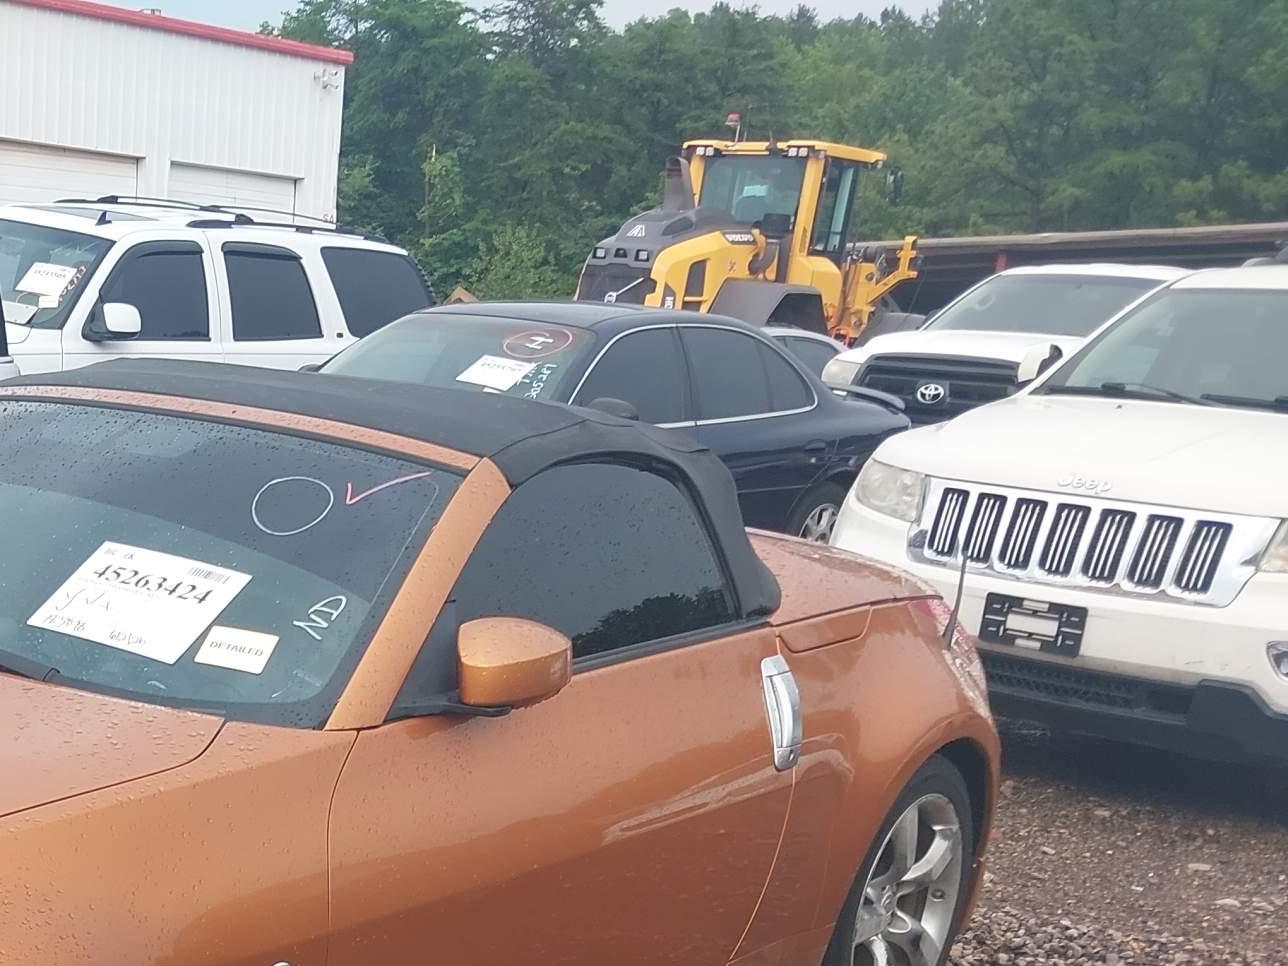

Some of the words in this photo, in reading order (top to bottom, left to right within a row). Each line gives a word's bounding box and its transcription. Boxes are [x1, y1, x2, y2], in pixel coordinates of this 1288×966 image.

[1056, 472, 1113, 495] Jeep
[93, 563, 214, 606] 45263424
[209, 640, 264, 657] DETAILED
